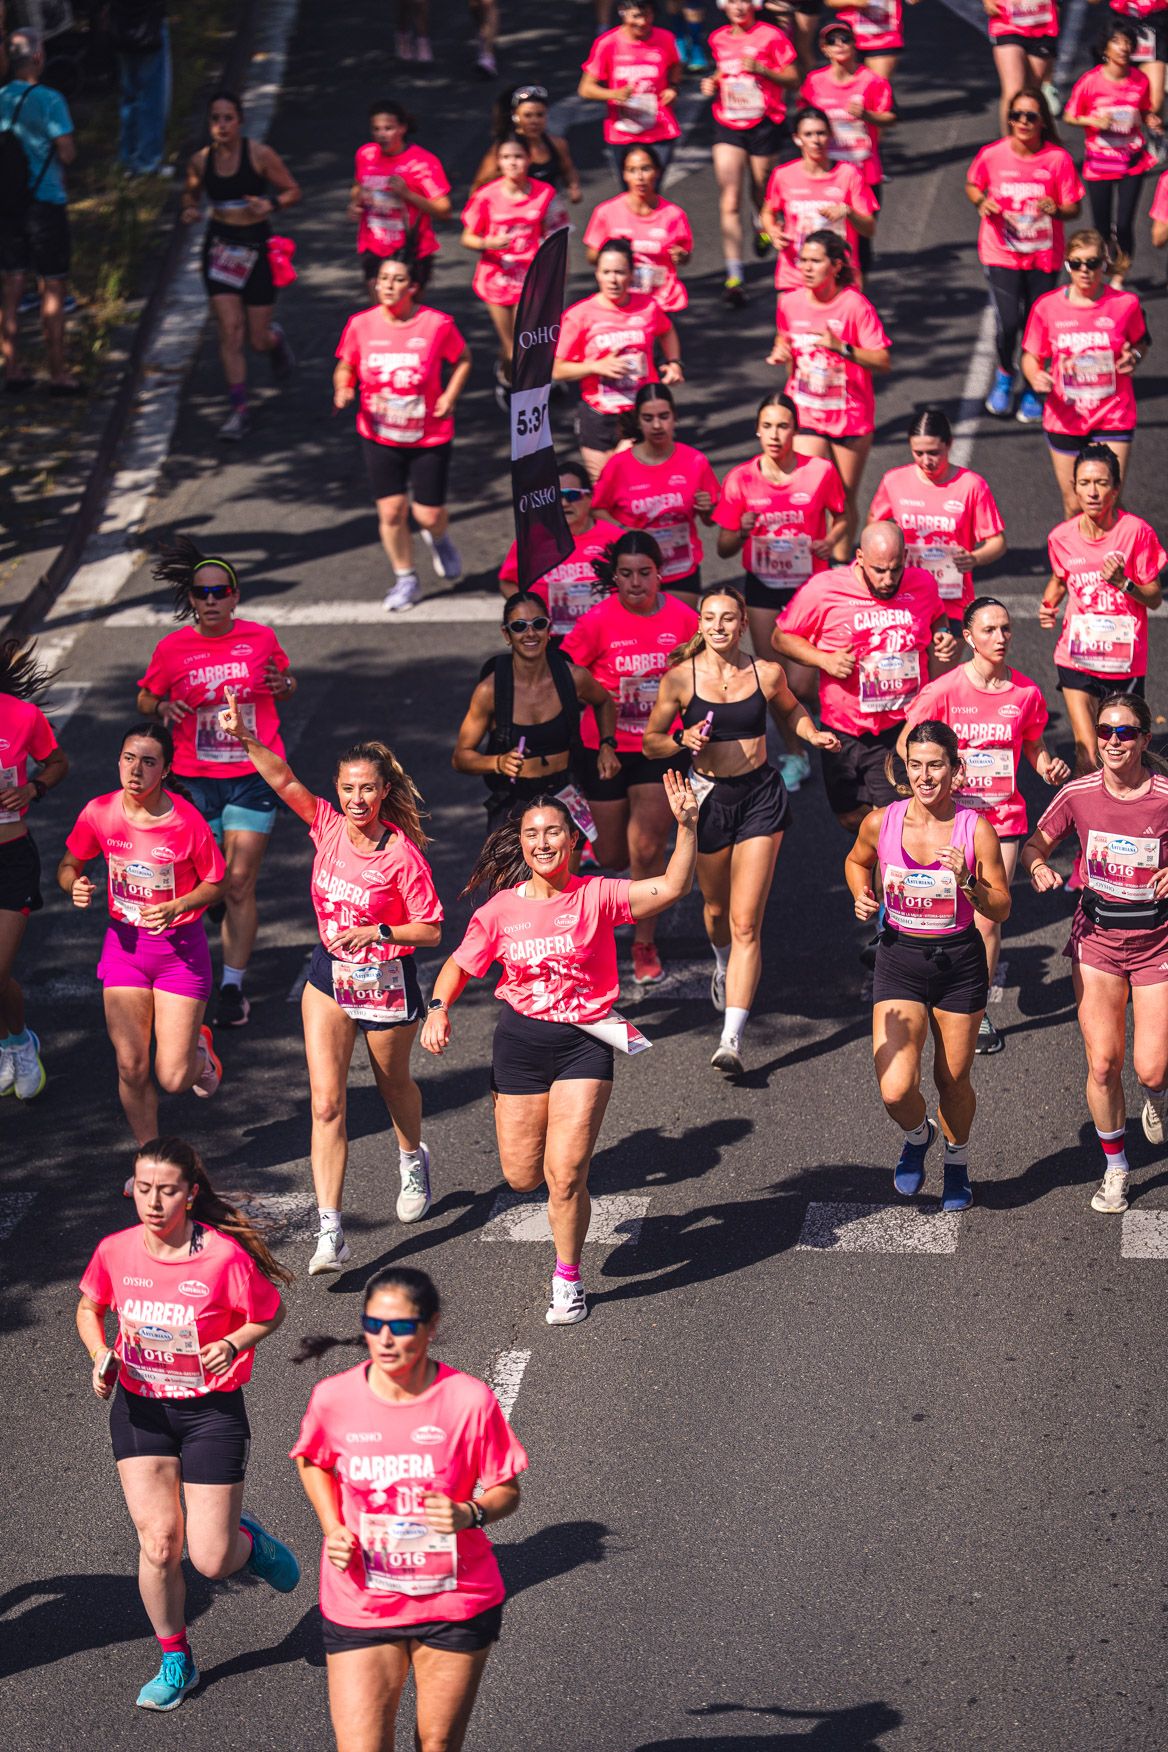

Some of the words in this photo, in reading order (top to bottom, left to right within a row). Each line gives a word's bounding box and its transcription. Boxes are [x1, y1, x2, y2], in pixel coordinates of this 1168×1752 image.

[755, 510, 804, 527] ARRERA
[902, 513, 956, 532] CARRERA
[854, 609, 912, 631] CARRERA
[1090, 641, 1113, 652] 016
[615, 653, 669, 672] CARRER
[189, 662, 249, 686] CARRERA
[880, 680, 903, 690] 016
[953, 723, 1012, 741] CARRERA
[967, 776, 993, 787] 016
[107, 839, 133, 849] OYSHO
[1108, 863, 1134, 876] 016
[129, 885, 153, 898] 016
[316, 869, 370, 908] CARRERA
[905, 897, 933, 908] 016
[504, 922, 531, 934] OYSHO
[510, 934, 576, 961] CARRERA
[356, 990, 383, 999] 016
[123, 1276, 153, 1288] OYSHO
[122, 1299, 195, 1327] CARRERA
[144, 1349, 174, 1363] 016
[350, 1454, 436, 1481] CARRERA
[397, 1486, 425, 1515] DE
[389, 1552, 426, 1567] 016
